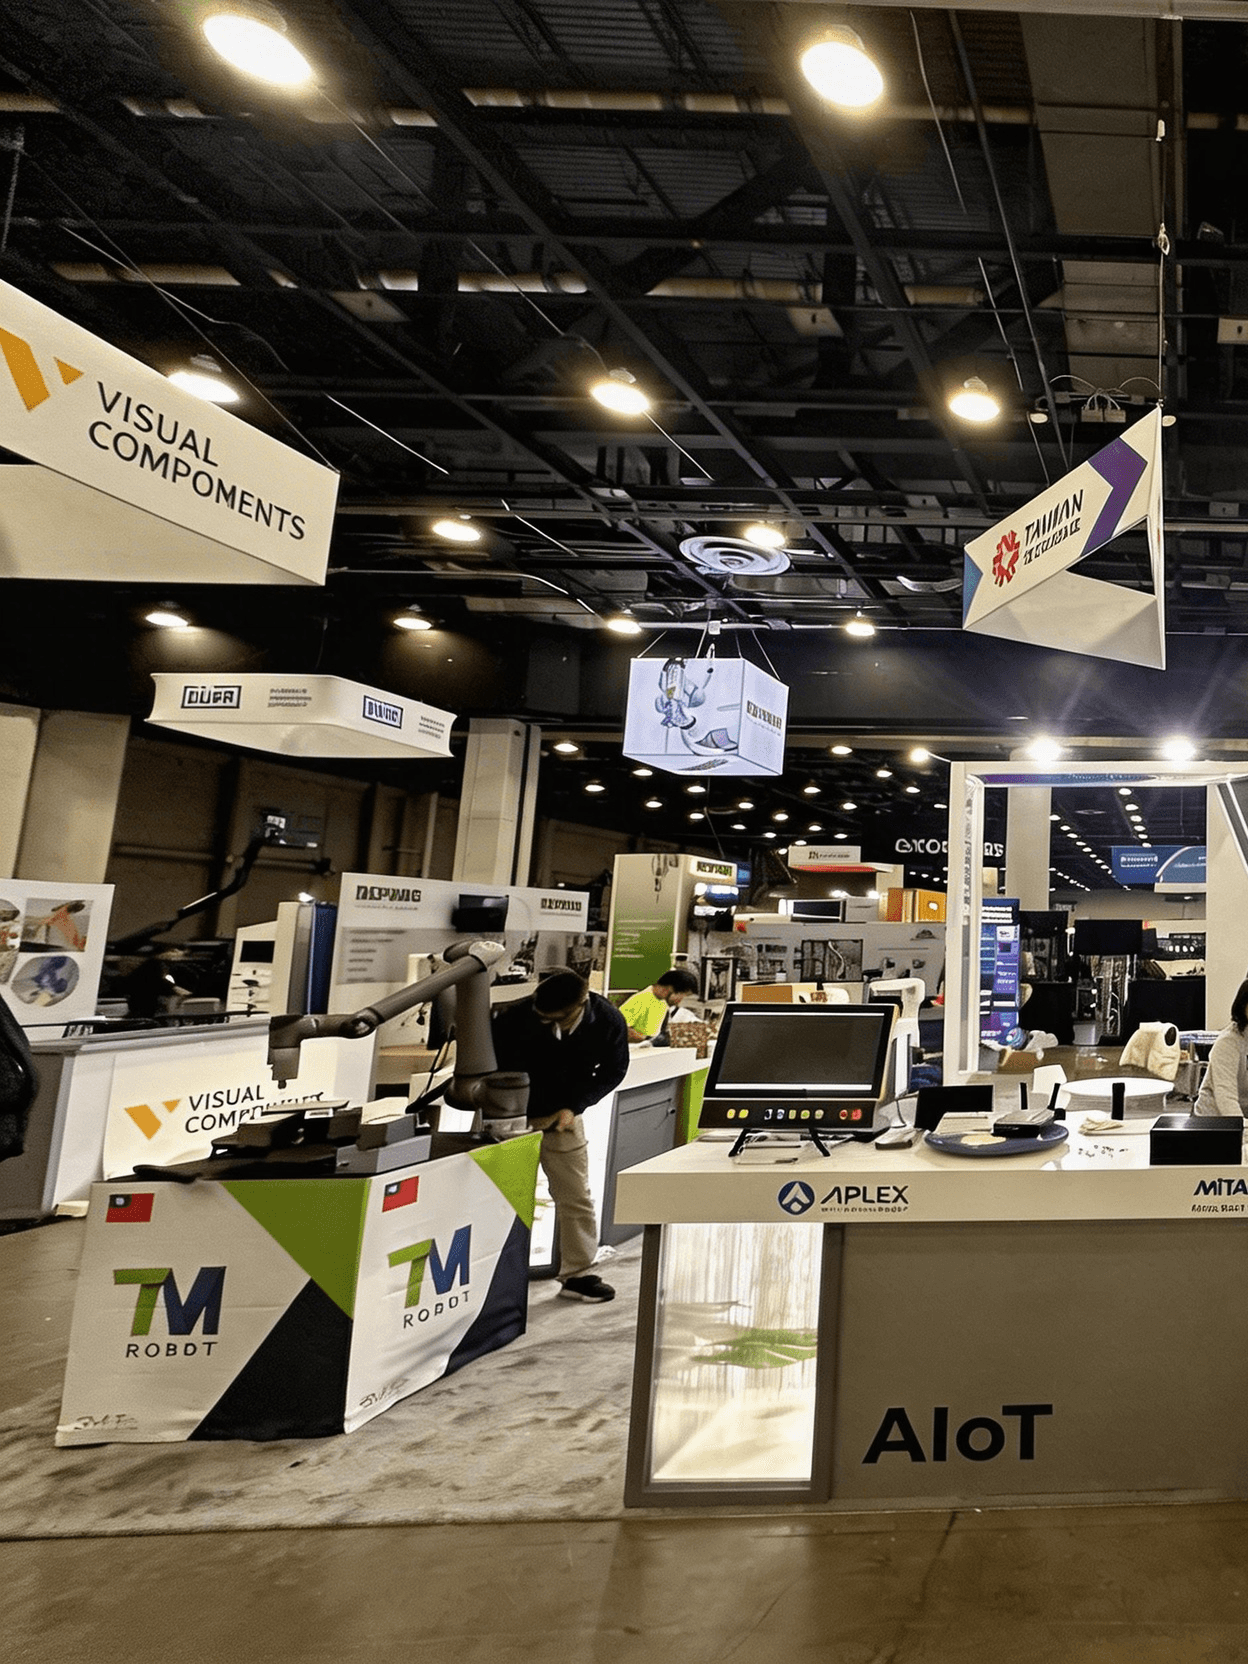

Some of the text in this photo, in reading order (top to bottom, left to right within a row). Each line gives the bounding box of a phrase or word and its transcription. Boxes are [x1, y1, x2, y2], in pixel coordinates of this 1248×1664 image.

[97, 381, 218, 467] VISUAL
[189, 1085, 265, 1112] VISUAL
[820, 1185, 909, 1205] APLEX
[387, 1223, 472, 1309] TM
[112, 1265, 227, 1336] TM
[861, 1403, 1053, 1464] AIoT
